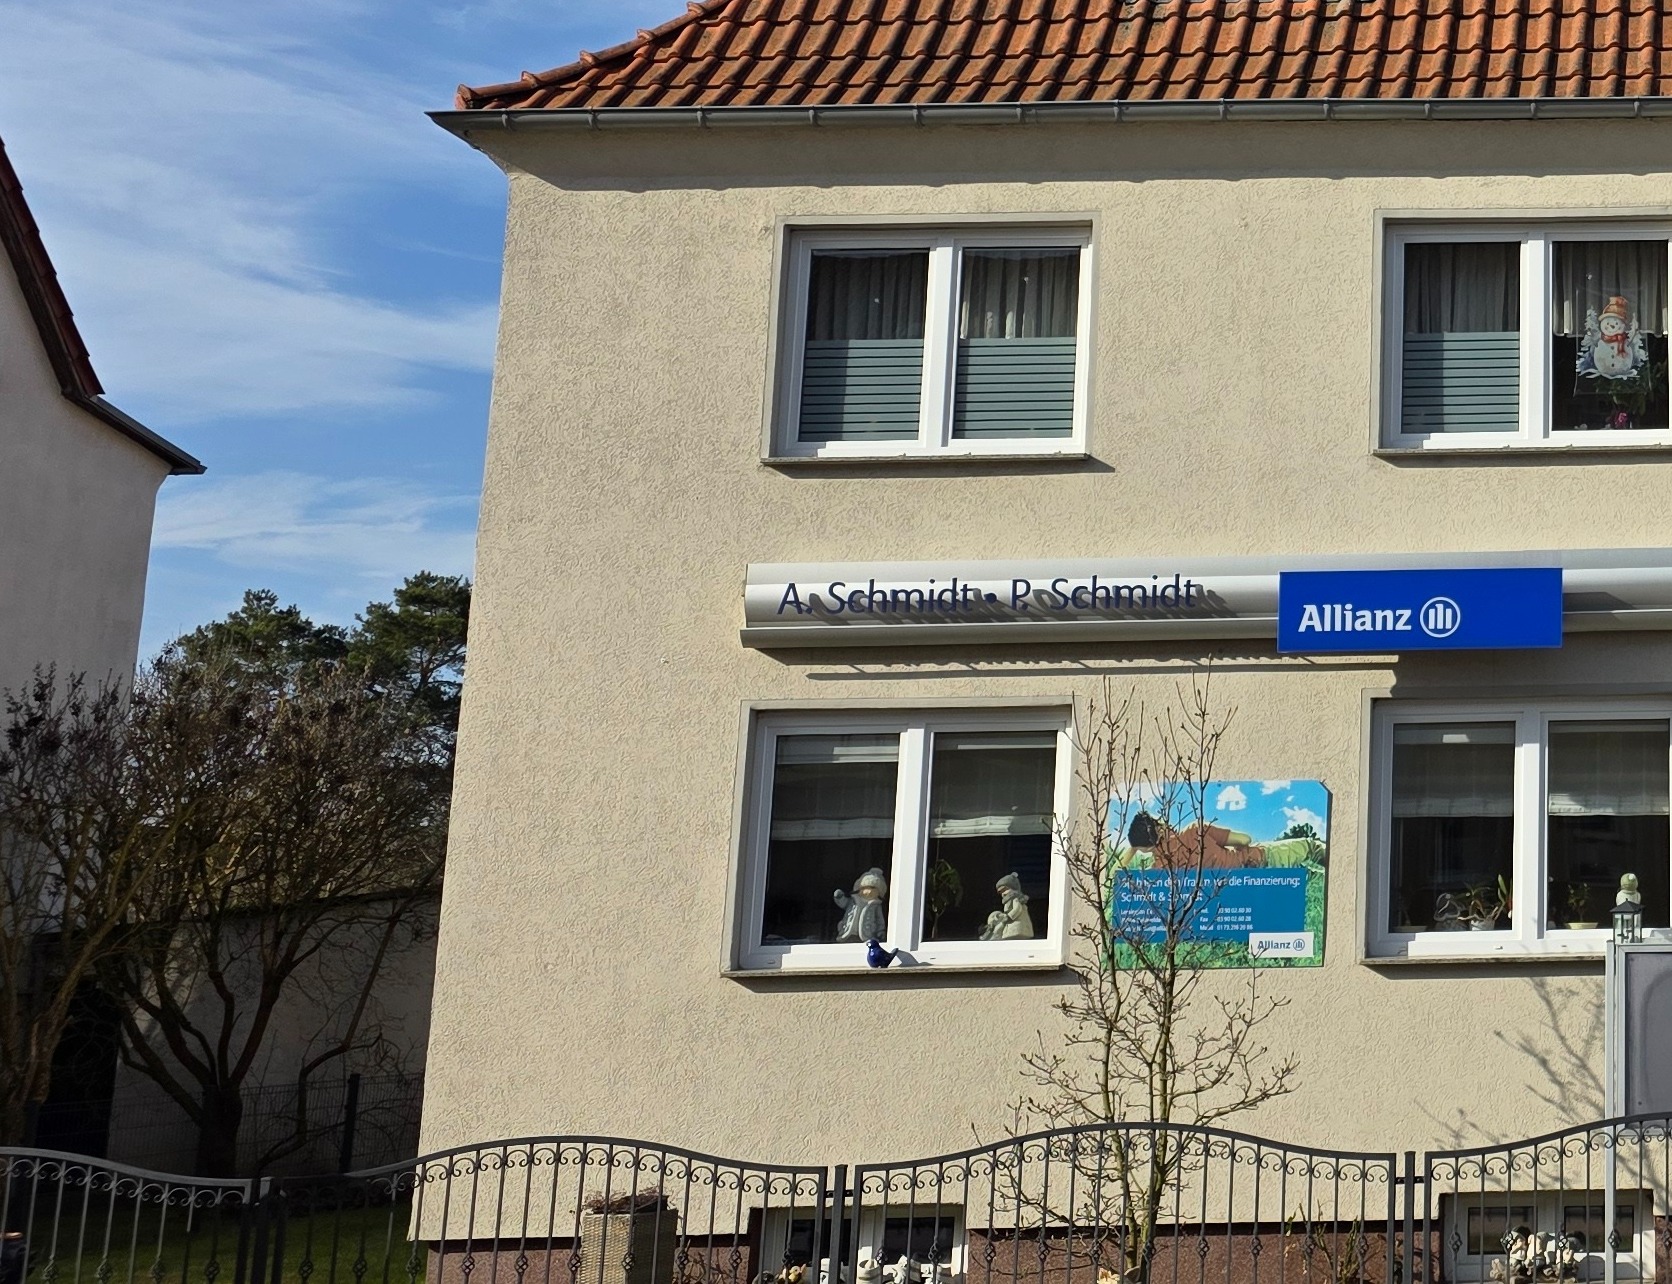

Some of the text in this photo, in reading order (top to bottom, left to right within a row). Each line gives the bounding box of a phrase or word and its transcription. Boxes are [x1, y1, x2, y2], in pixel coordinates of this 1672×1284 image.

[777, 573, 1195, 615] A. Schmidt P. Schmidt
[1298, 603, 1412, 633] Allianz
[1228, 876, 1242, 886] die
[1243, 875, 1301, 888] Finanzierung:
[1158, 891, 1166, 902] &
[1257, 940, 1291, 950] Allianz
